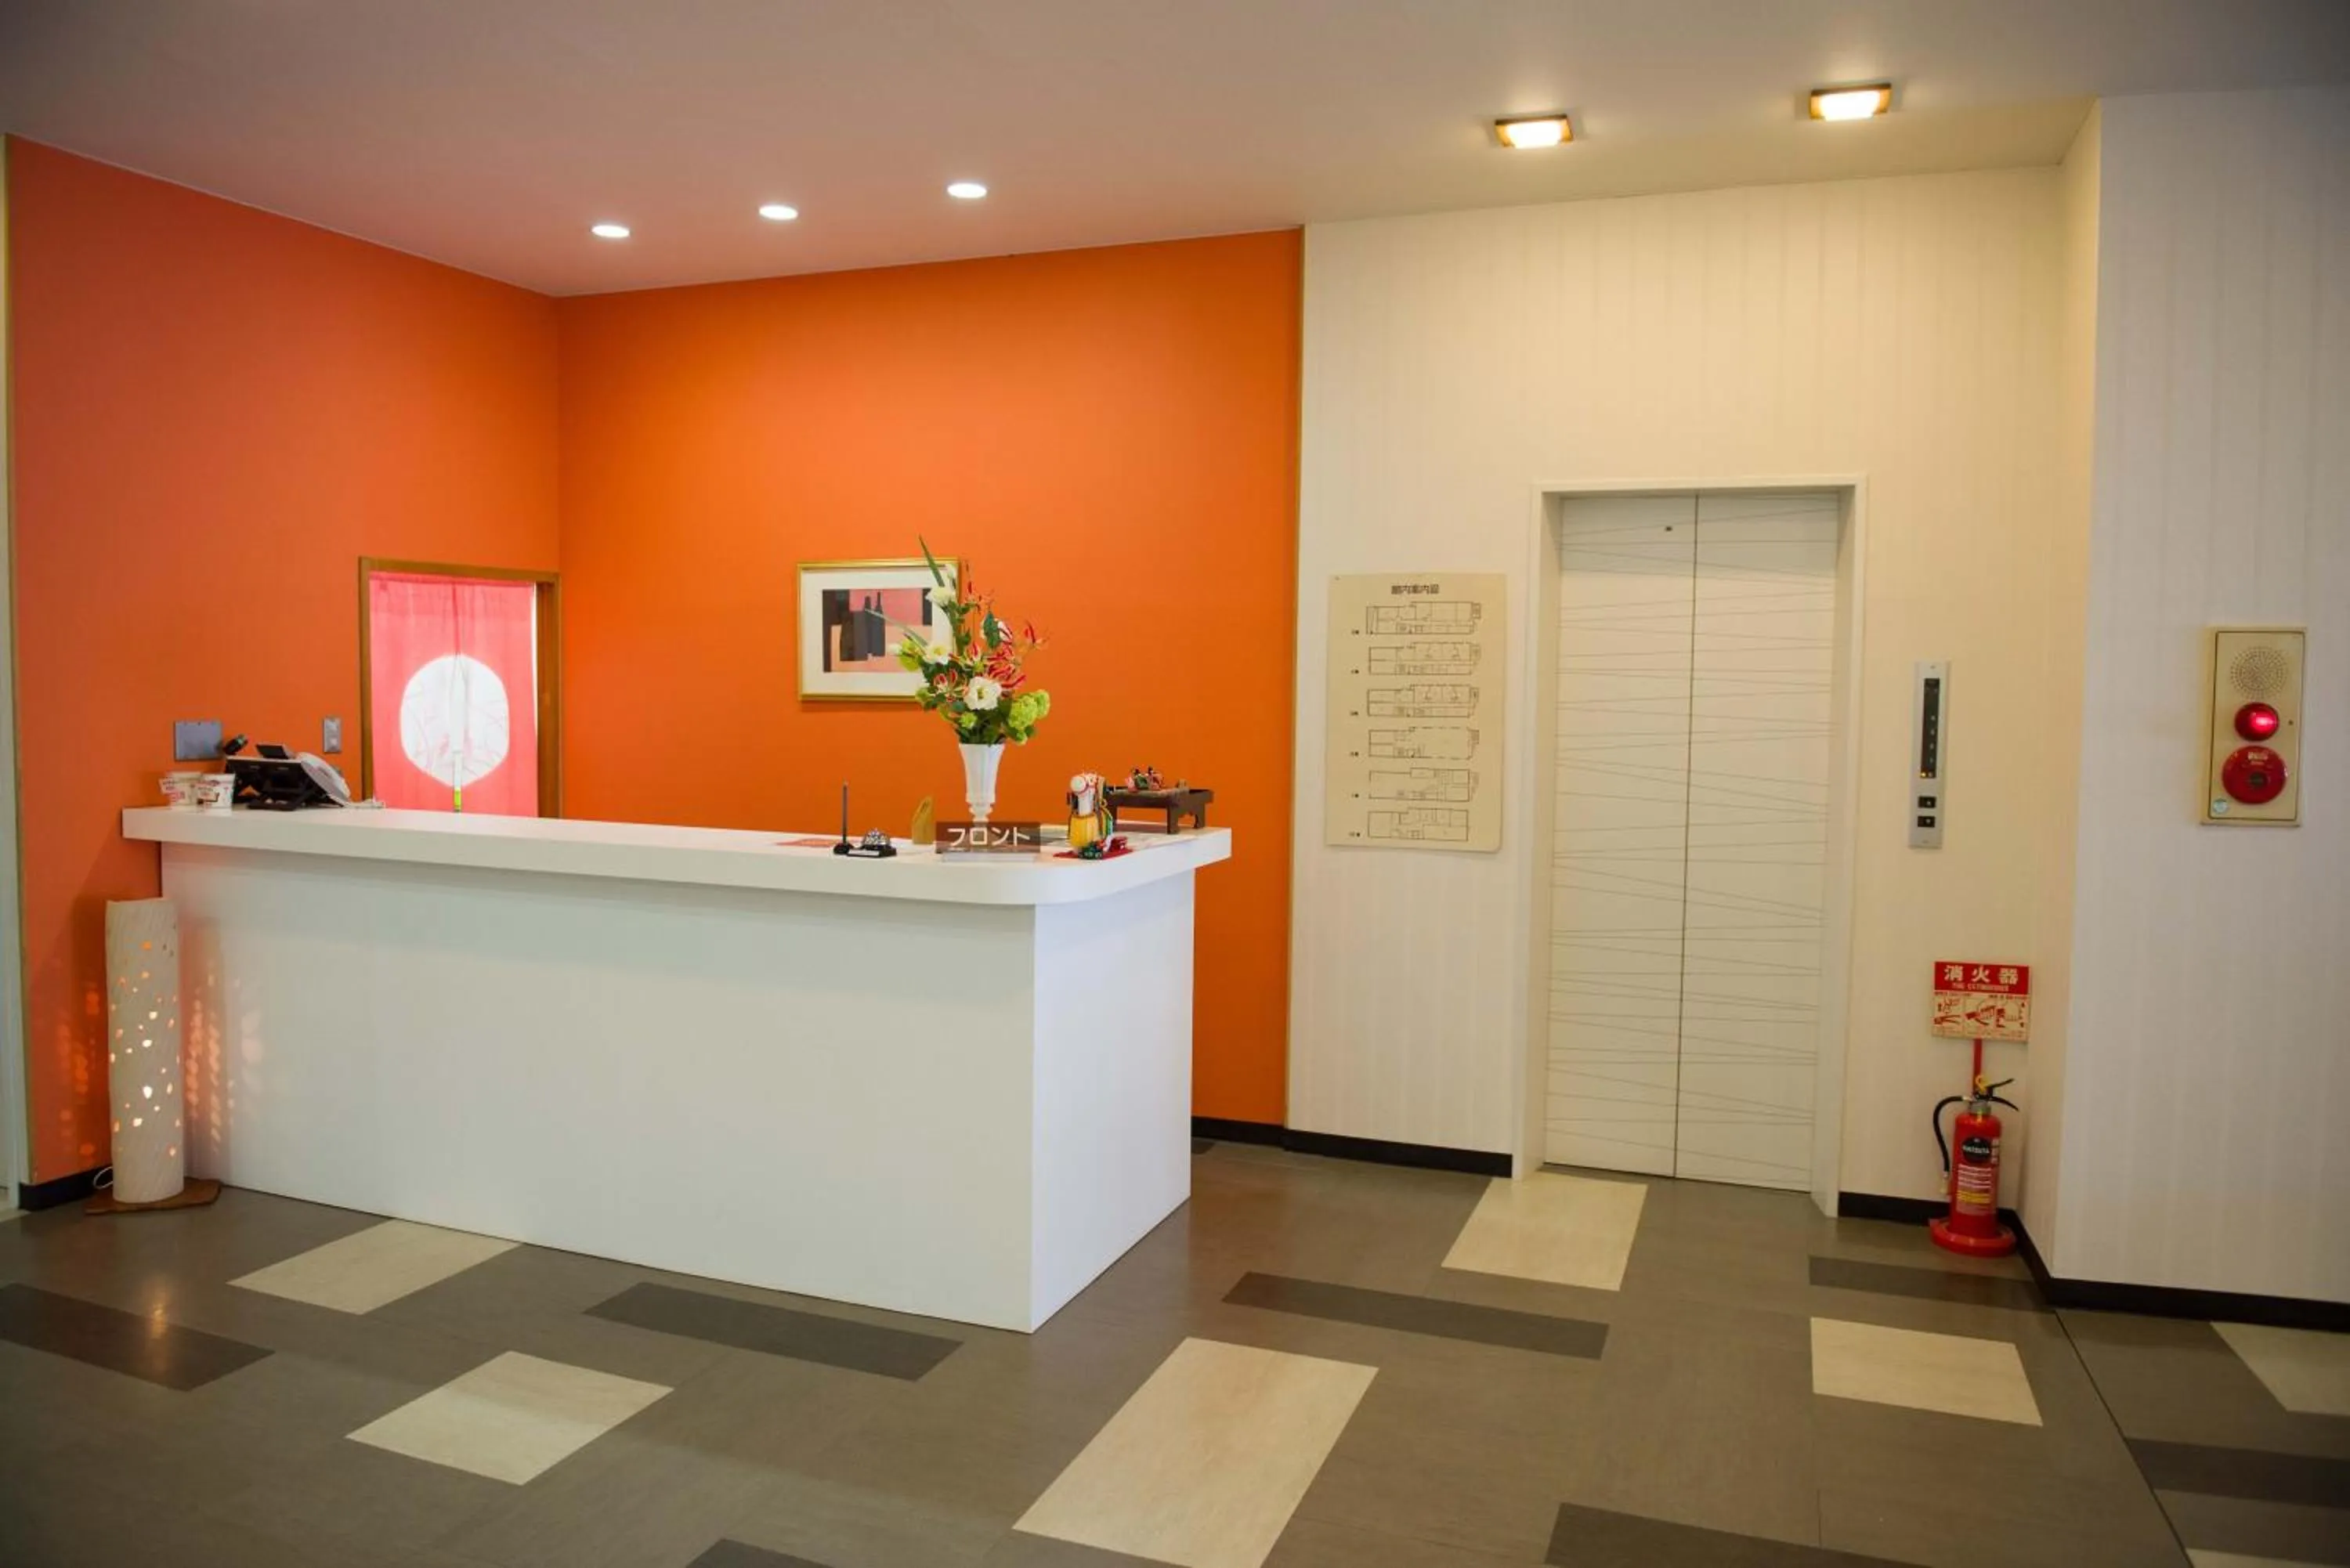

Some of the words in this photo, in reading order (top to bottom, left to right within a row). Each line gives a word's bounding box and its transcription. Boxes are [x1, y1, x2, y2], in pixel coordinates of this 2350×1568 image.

[947, 827, 1030, 846] フロント
[1943, 964, 2019, 985] 消火器
